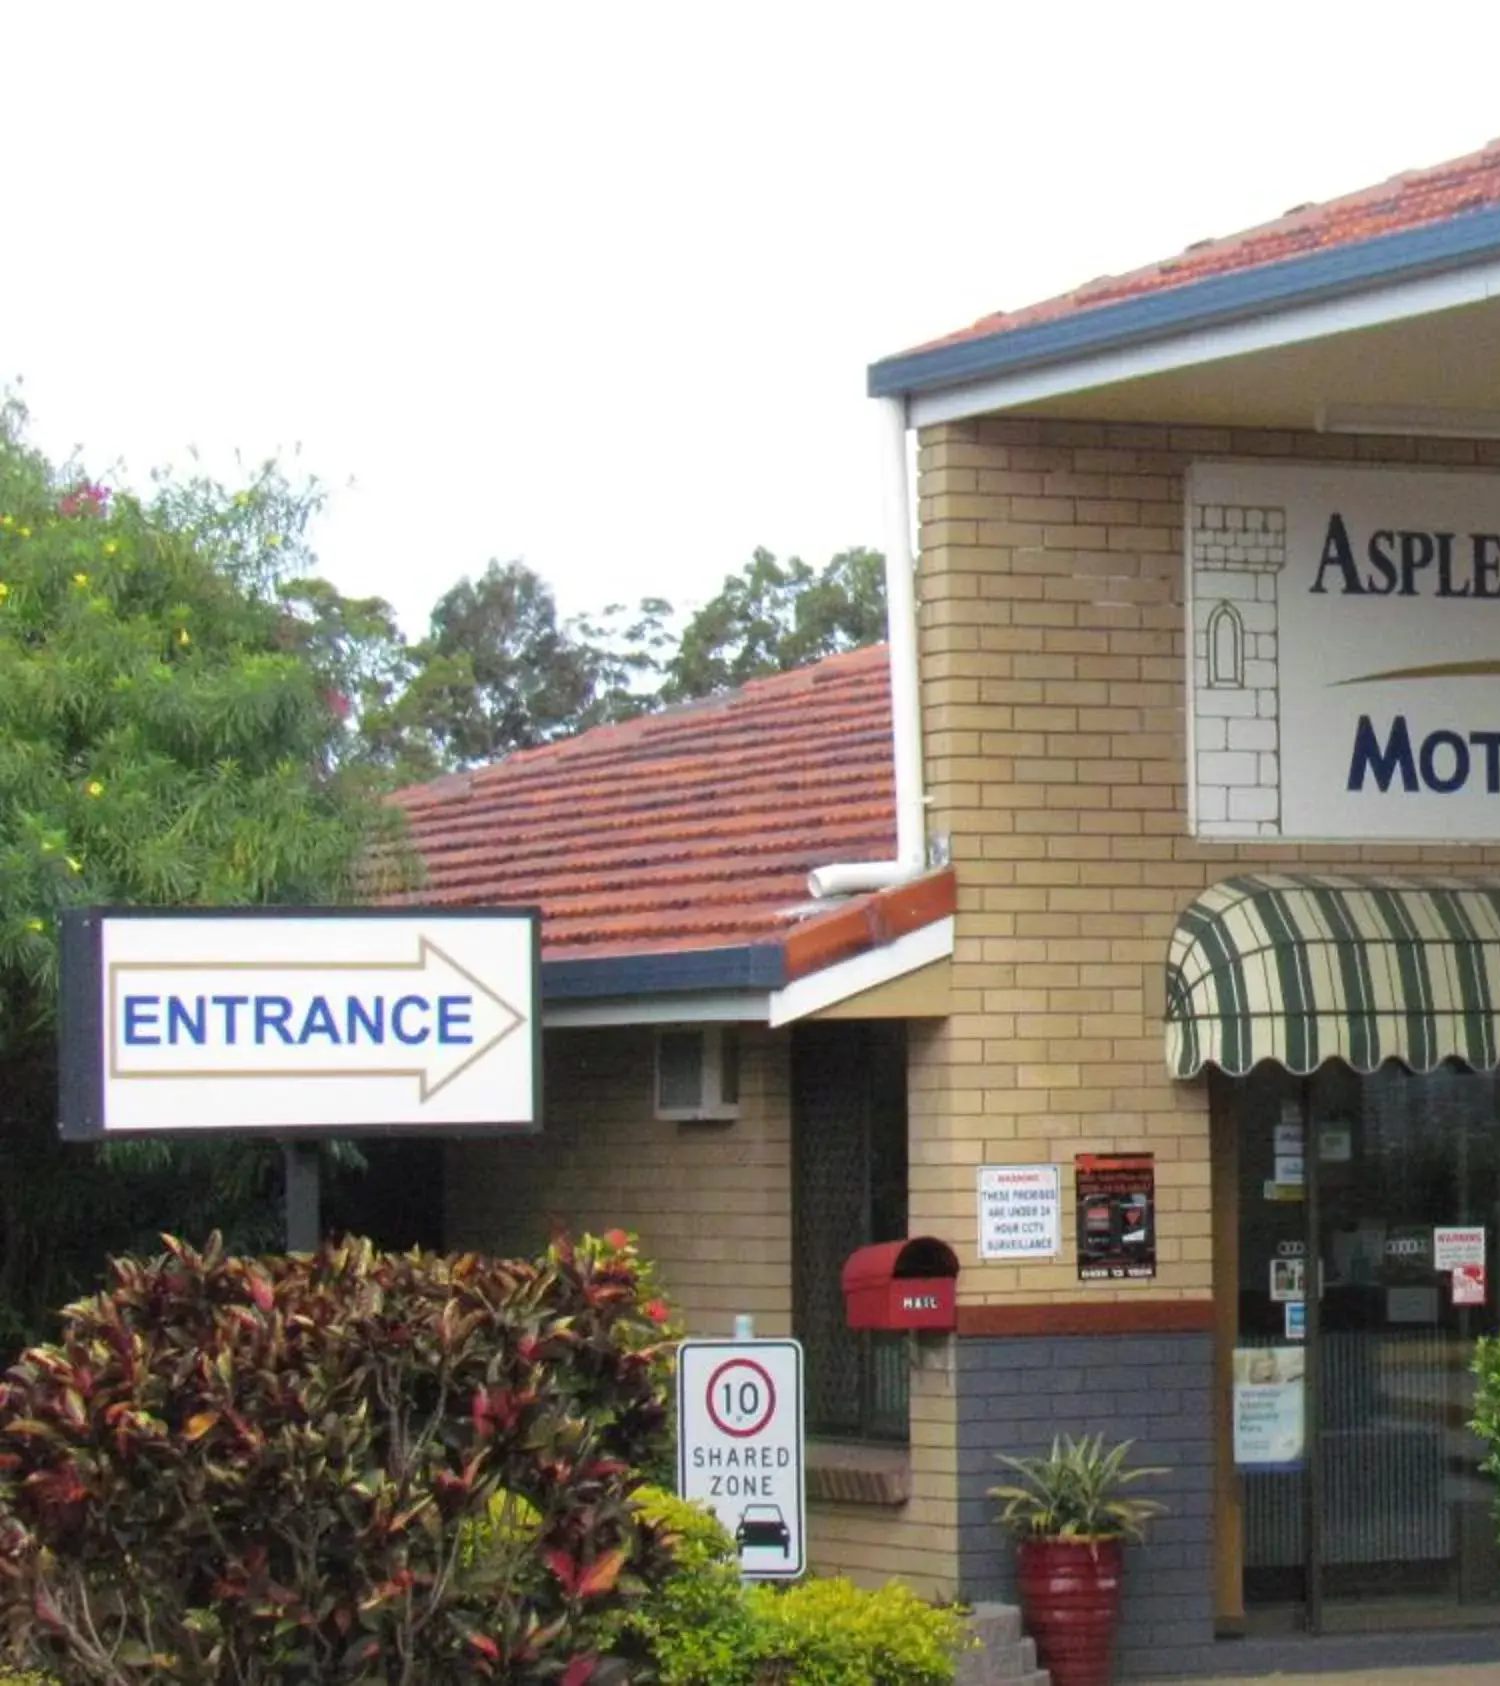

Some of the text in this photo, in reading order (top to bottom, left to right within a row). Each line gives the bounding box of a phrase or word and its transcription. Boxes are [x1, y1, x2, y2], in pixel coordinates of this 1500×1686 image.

[122, 994, 475, 1046] ENTRANCE
[982, 1190, 1010, 1201] THESE
[988, 1207, 1005, 1217] ARE
[1008, 1206, 1038, 1217] UNDER
[994, 1223, 1045, 1234] HOUR CCTV
[987, 1238, 1052, 1251] SURVEILLANCE
[903, 1295, 938, 1310] MAIL
[721, 1381, 760, 1417] 10
[692, 1446, 790, 1469] SHARED
[709, 1475, 775, 1497] ZONE
